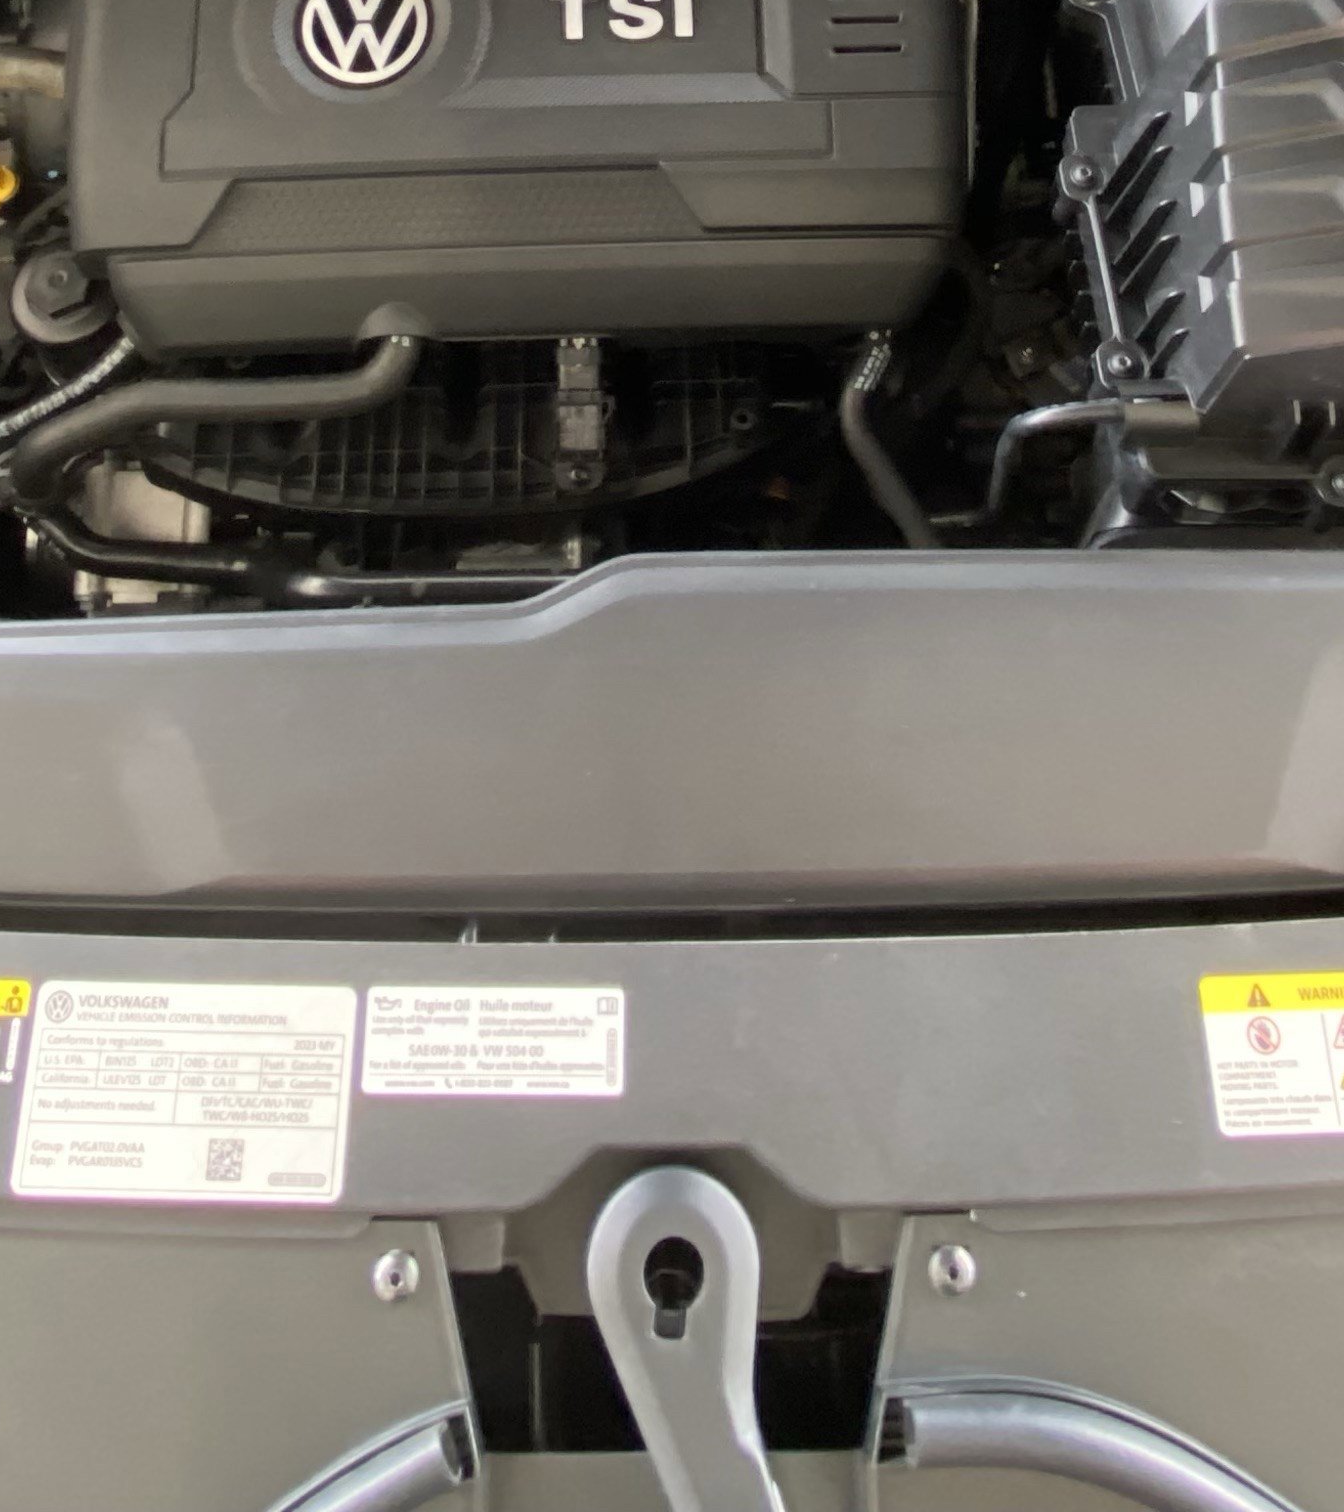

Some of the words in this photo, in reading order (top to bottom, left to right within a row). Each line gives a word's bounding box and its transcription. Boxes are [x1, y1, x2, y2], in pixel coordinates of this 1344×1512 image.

[79, 995, 169, 1009] VOLKSWAGEN
[414, 999, 452, 1015] Engine
[453, 999, 470, 1011] Oil
[479, 998, 509, 1012] Huile
[511, 1000, 553, 1012] moteur
[77, 1012, 116, 1022] VEHICLE
[118, 1012, 166, 1023] EMISSION
[168, 1013, 213, 1024] CONTROL
[216, 1014, 288, 1025] INFORMATION
[47, 1034, 94, 1045] Conforms
[96, 1036, 106, 1045] to
[294, 1040, 317, 1050] 2023
[408, 1044, 429, 1057] SAE
[483, 1044, 503, 1057] VW
[38, 1098, 52, 1108] No
[54, 1096, 116, 1112] adjustments
